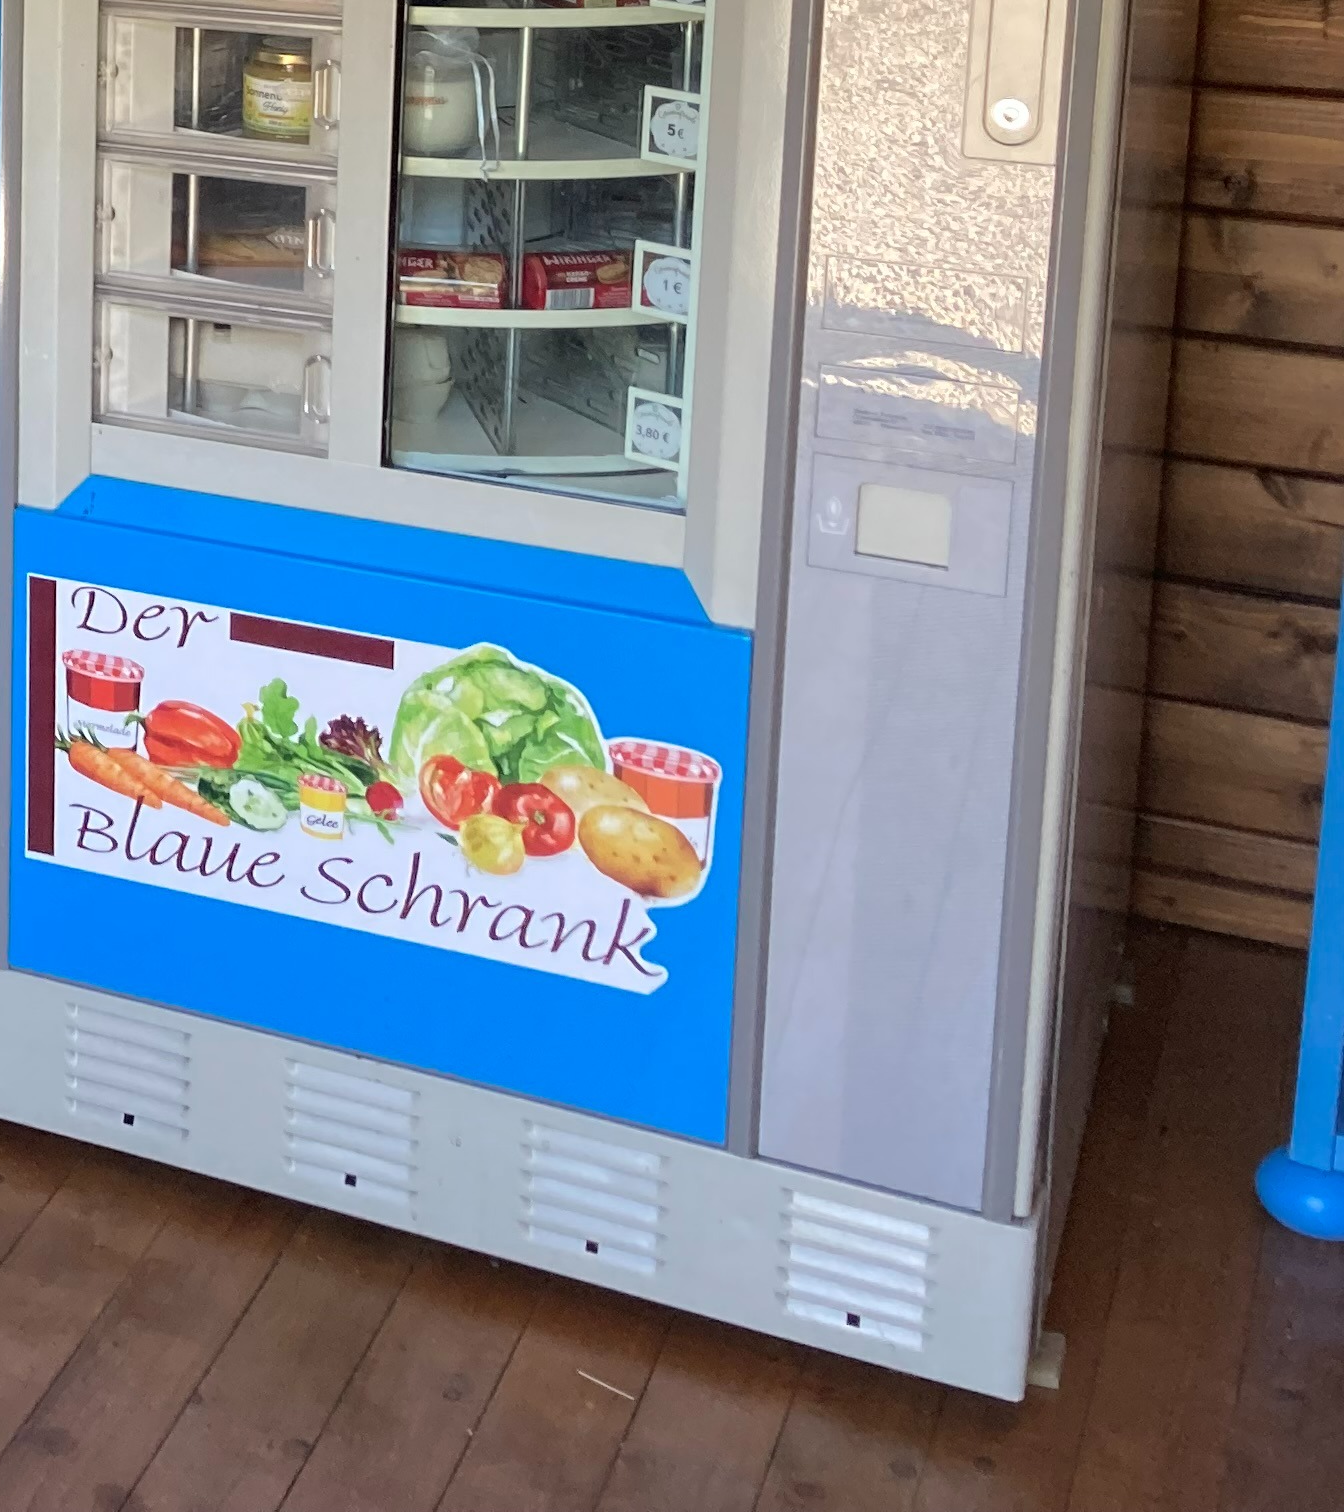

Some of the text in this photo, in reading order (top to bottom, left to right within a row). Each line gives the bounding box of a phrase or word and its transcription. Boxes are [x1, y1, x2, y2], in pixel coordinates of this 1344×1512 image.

[667, 123, 676, 136] 5
[542, 255, 612, 266] WIKINGER
[635, 424, 660, 440] 3,80
[71, 585, 218, 648] Der
[306, 814, 339, 829] Gelee
[69, 795, 663, 977] Blaue Schrank
